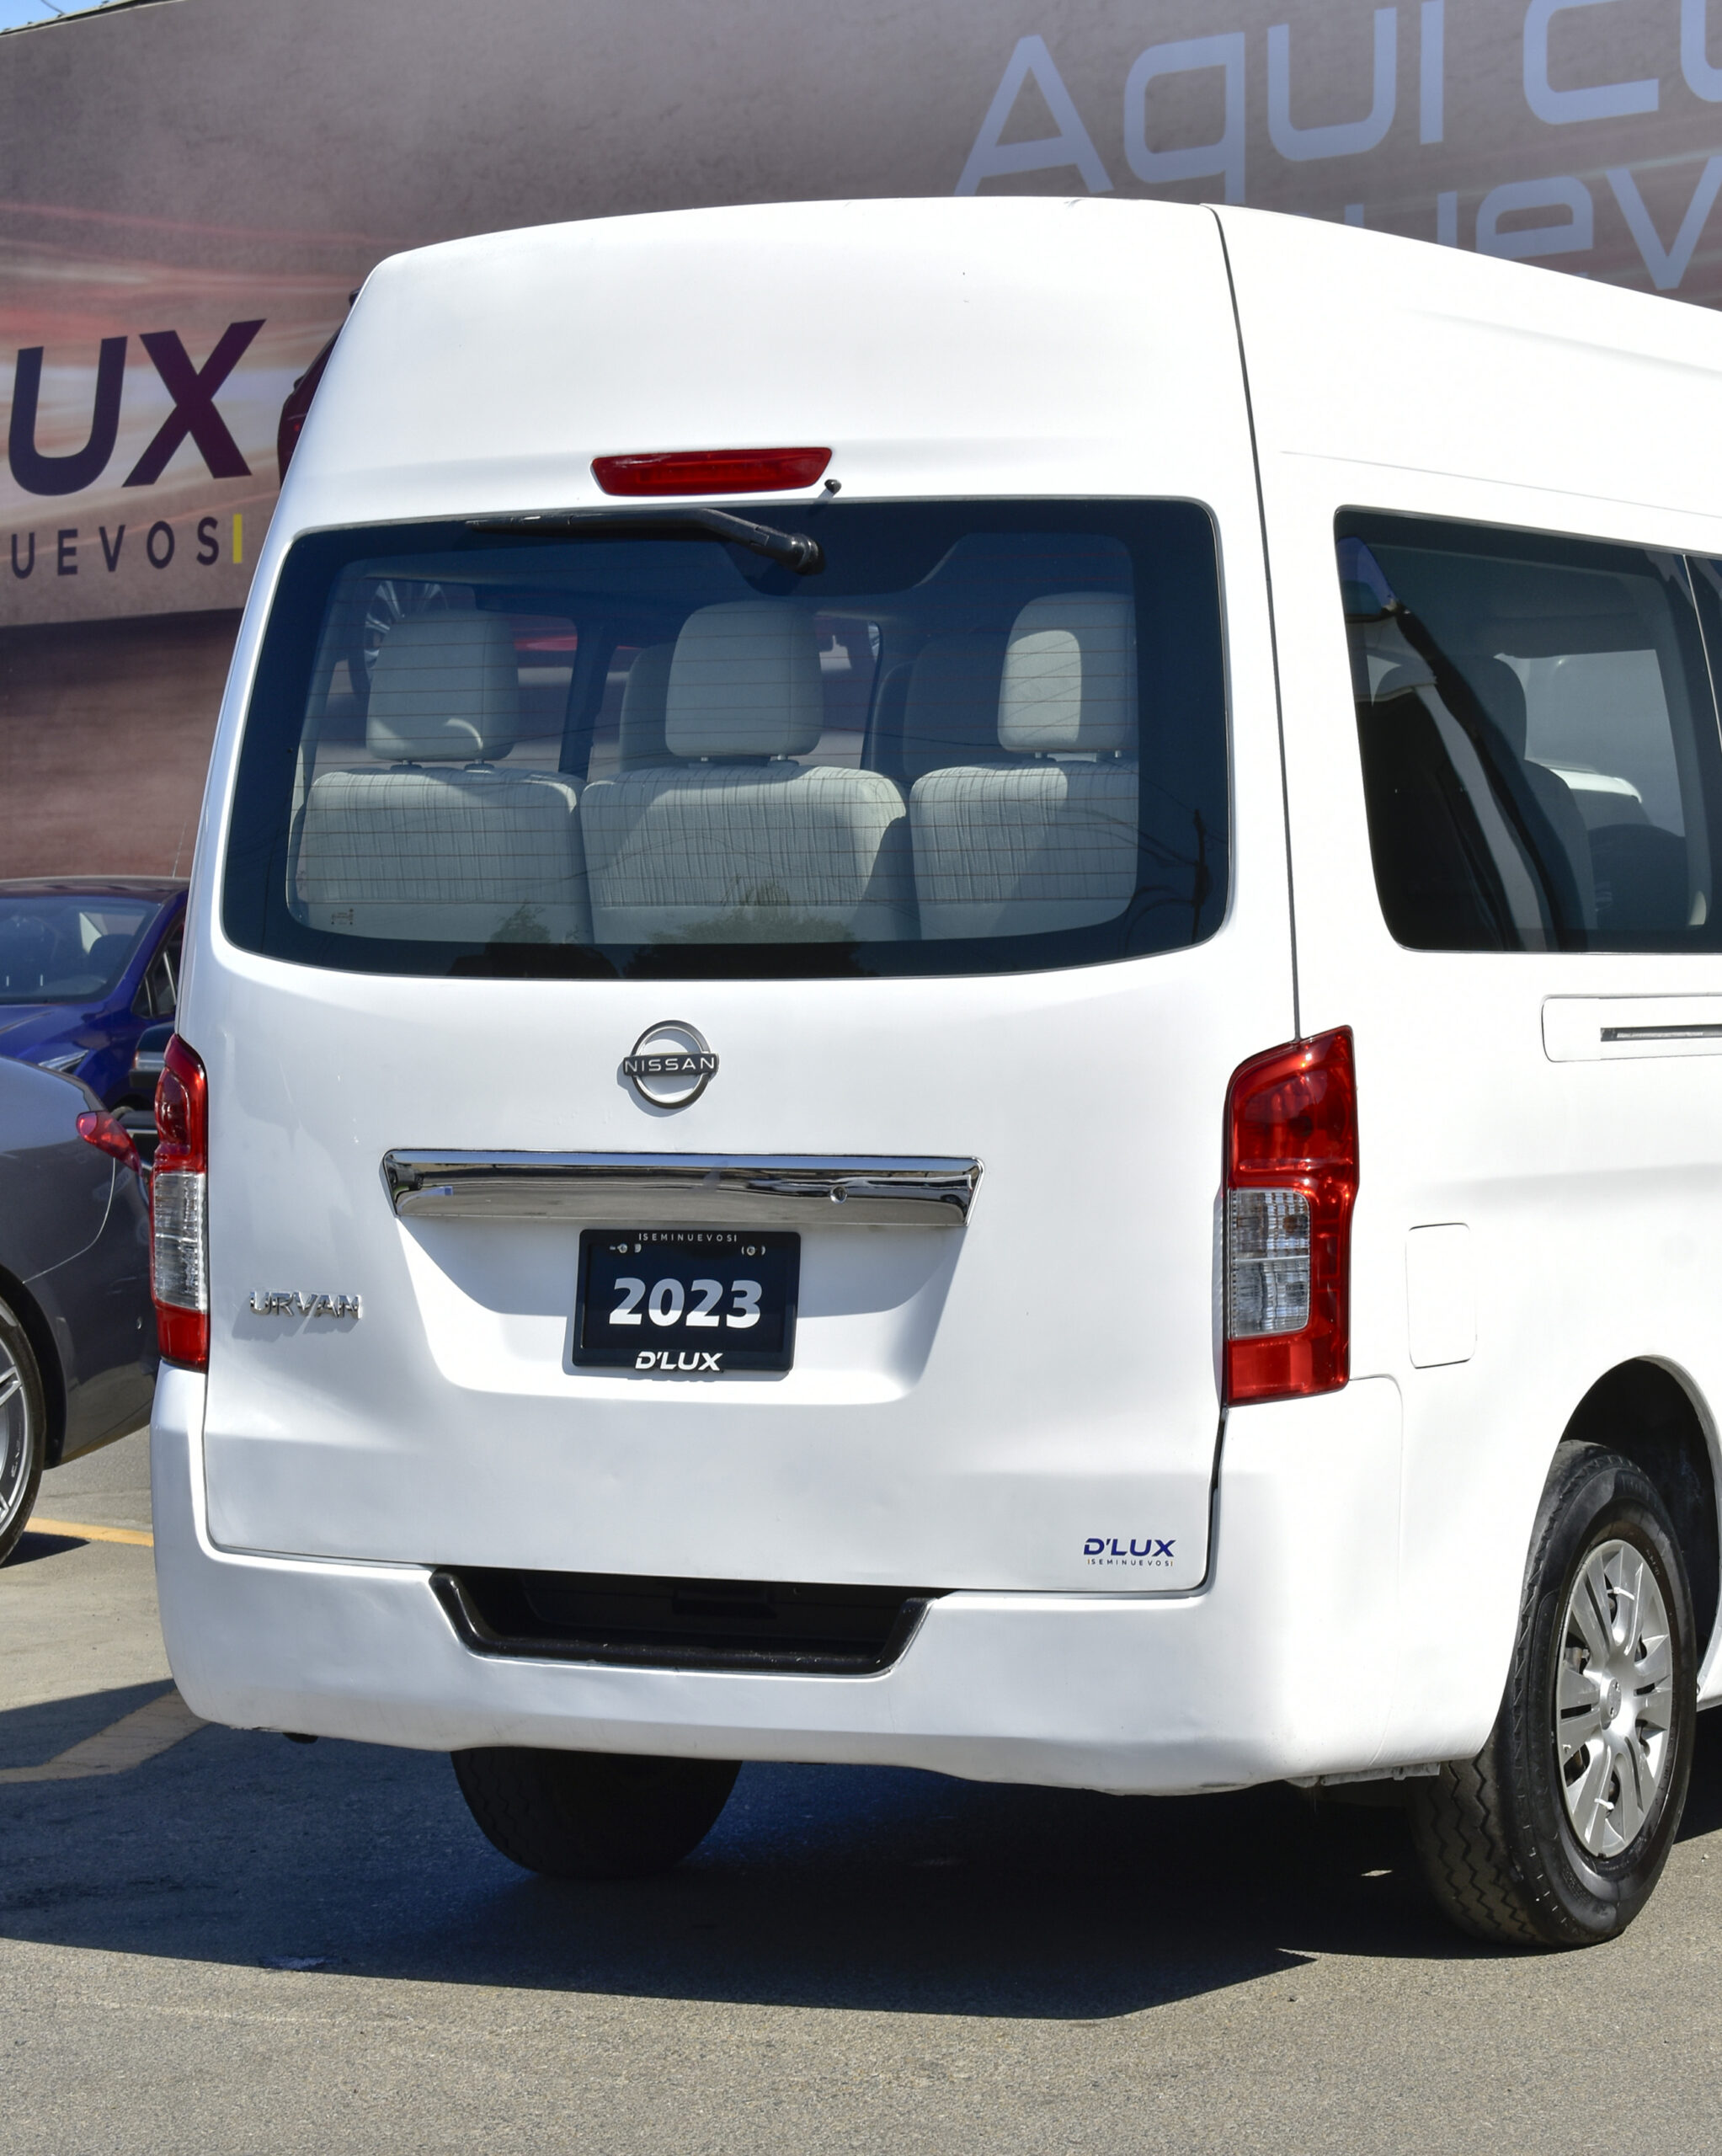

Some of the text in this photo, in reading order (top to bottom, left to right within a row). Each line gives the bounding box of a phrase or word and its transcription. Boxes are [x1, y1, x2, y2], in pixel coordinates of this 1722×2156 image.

[8, 318, 267, 497] UX
[625, 1057, 715, 1073] NISSAN
[249, 1291, 364, 1320] URVAN
[608, 1277, 764, 1329] 2023
[635, 1350, 723, 1372] D'LUX
[1083, 1537, 1176, 1557] D'LUX
